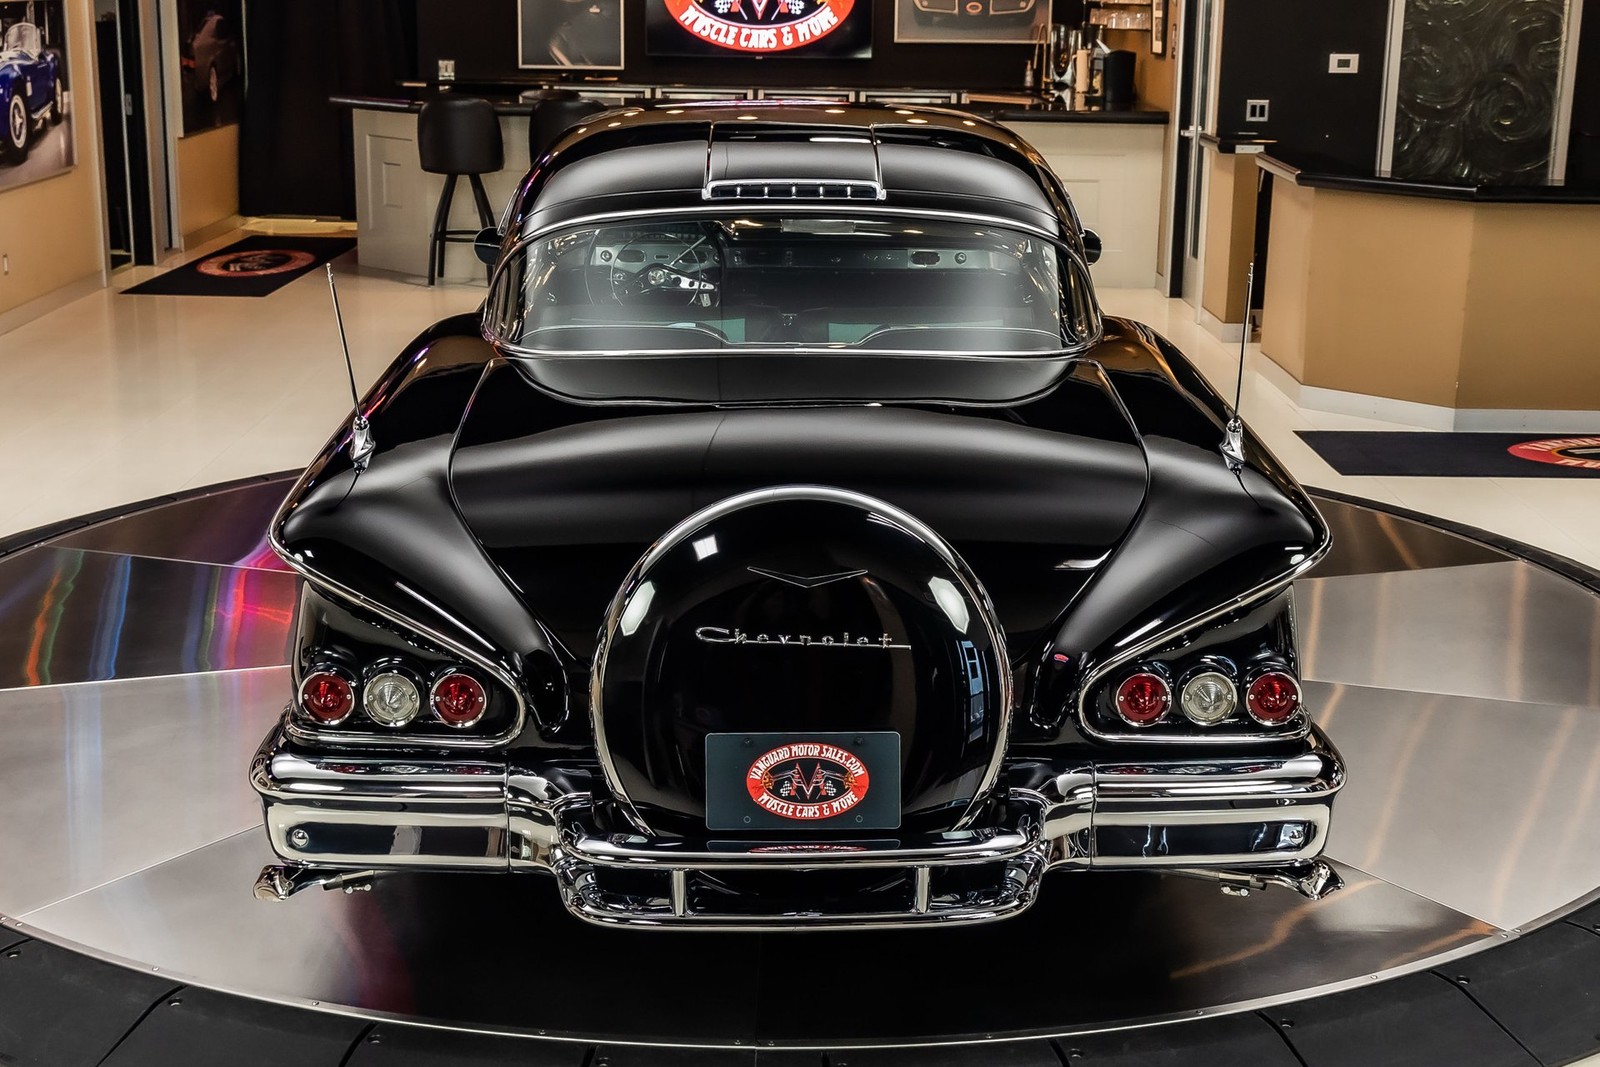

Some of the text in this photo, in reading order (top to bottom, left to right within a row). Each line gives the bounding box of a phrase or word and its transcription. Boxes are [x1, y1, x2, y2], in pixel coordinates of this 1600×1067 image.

[679, 5, 839, 49] MUSCLE CARS & MORE
[695, 626, 911, 650] Chevrolet
[750, 744, 865, 780] VANGUARD MOTOR SALES.COM
[757, 791, 858, 818] MUSCLE CARS & MORE
